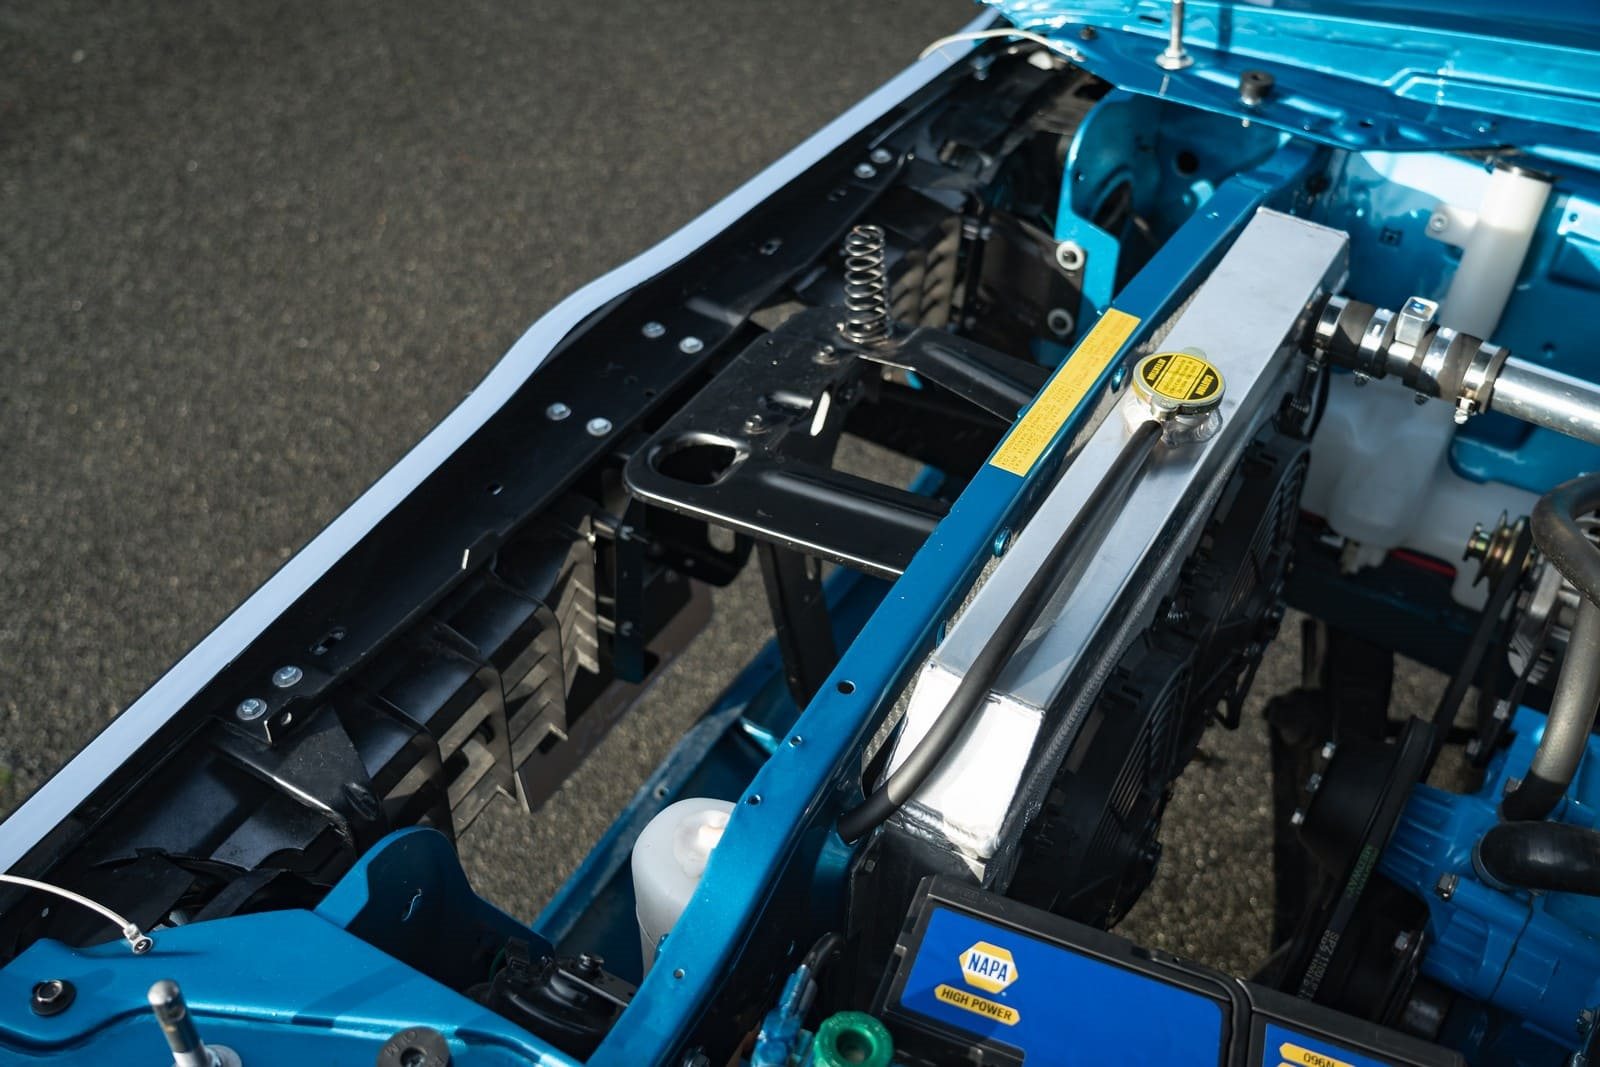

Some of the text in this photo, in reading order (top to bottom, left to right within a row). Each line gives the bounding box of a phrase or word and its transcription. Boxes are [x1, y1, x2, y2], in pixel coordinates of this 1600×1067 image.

[968, 953, 1008, 982] NAPA
[941, 987, 1013, 1021] HIGH POWER
